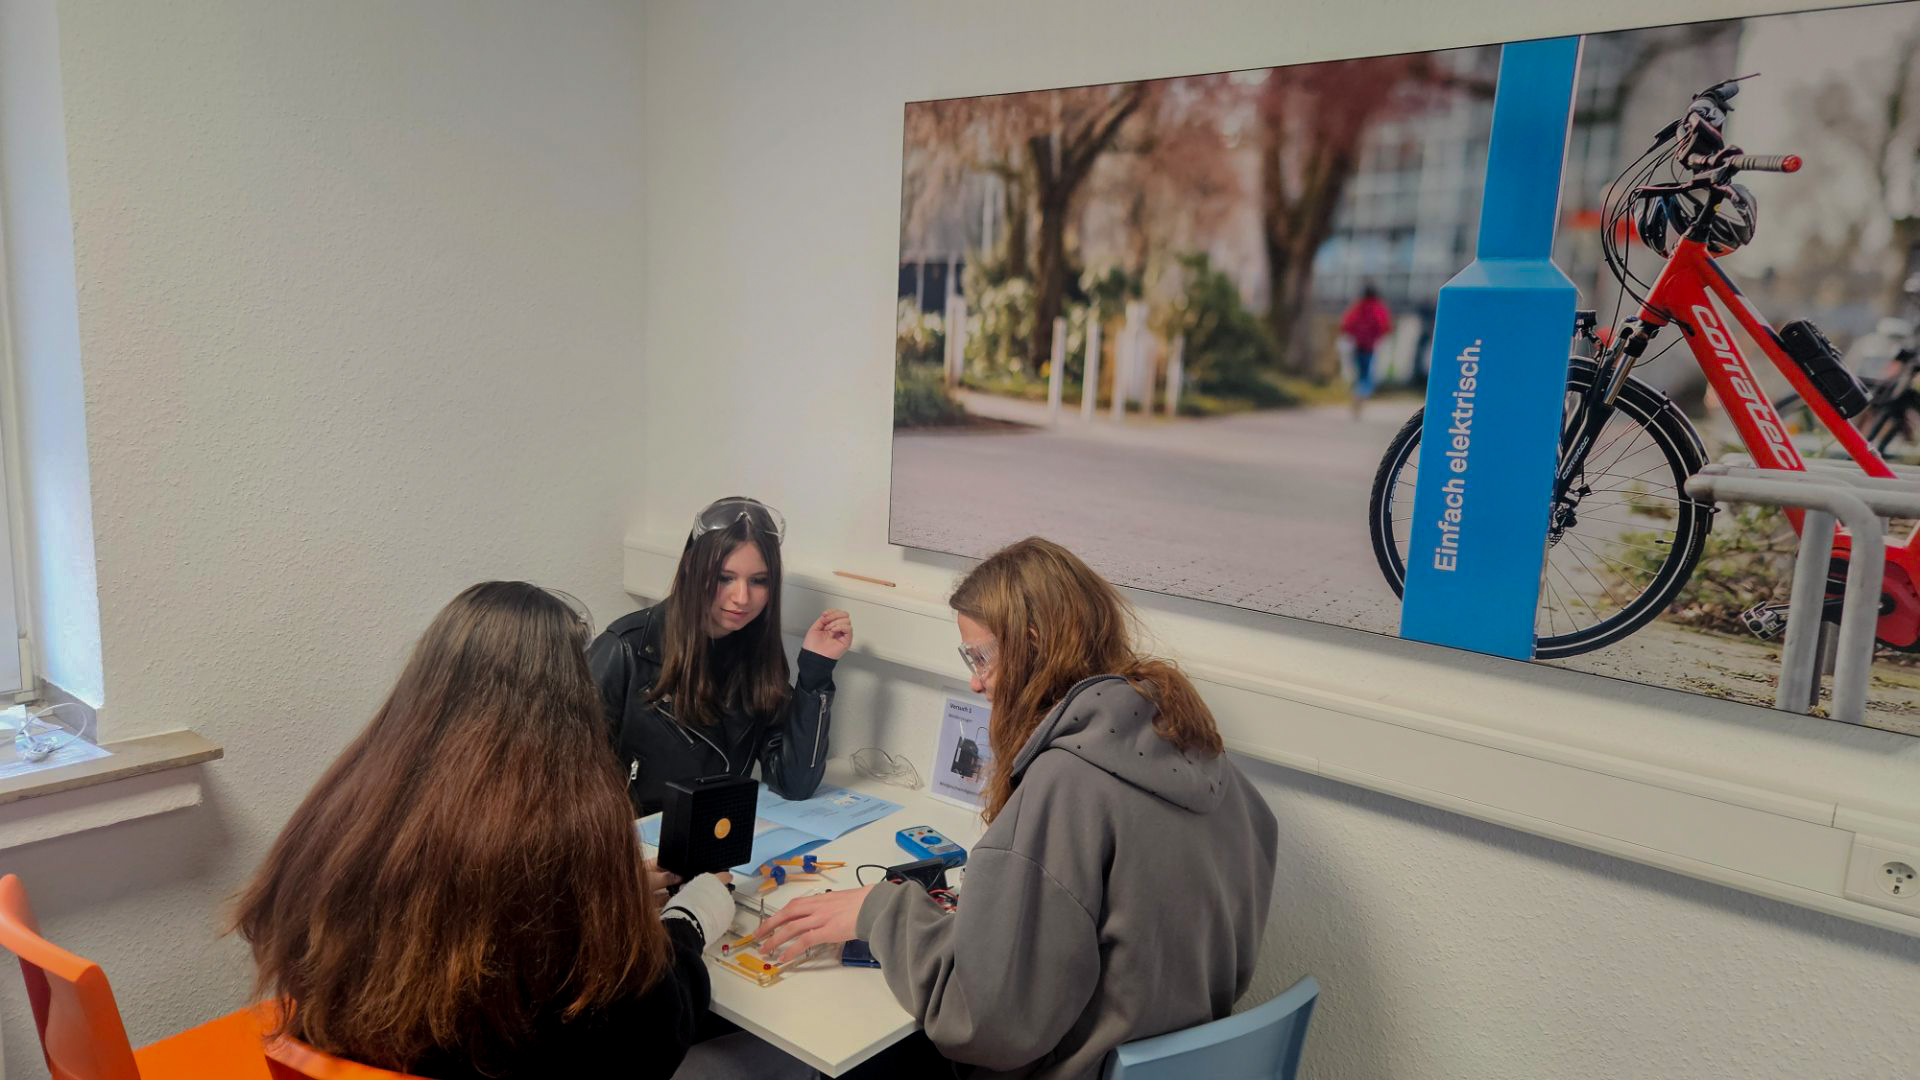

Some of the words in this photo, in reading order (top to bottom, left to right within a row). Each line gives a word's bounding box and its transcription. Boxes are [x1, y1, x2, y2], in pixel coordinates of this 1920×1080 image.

[1445, 339, 1482, 473] elektrisch.
[1692, 304, 1799, 469] corratec
[1434, 479, 1465, 571] Einfach
